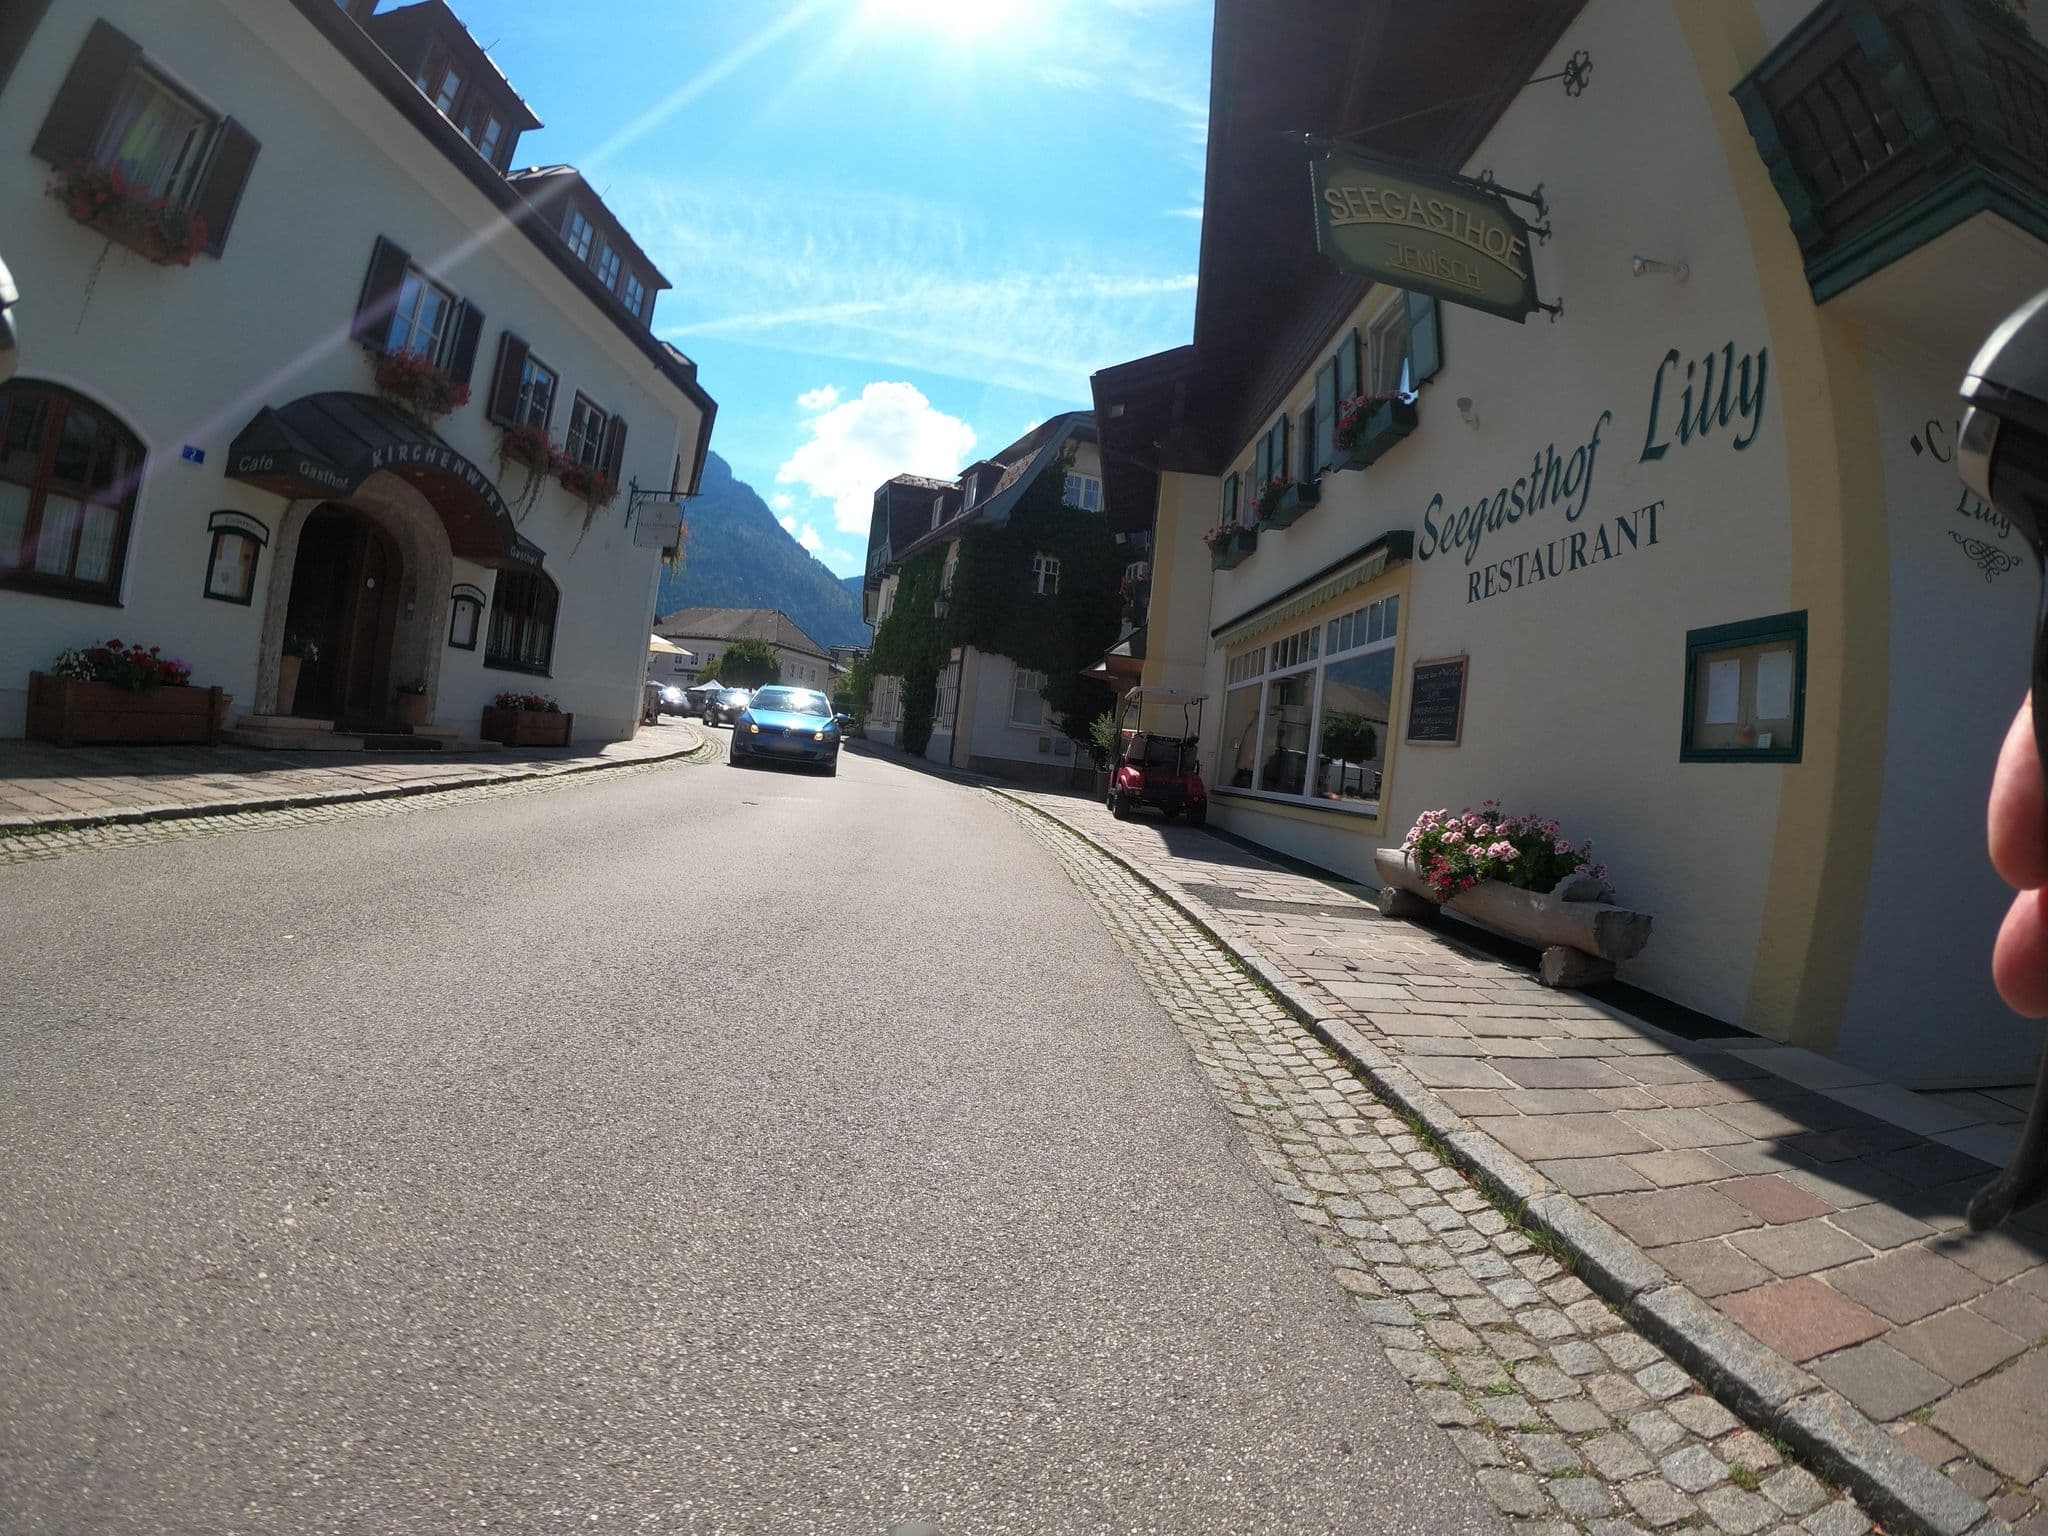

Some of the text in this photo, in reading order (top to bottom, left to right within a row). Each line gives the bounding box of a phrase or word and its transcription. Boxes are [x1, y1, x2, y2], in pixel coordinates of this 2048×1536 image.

[1323, 186, 1526, 266] SEEGASTHOF
[299, 460, 350, 489] Gasthof
[372, 443, 507, 518] KIRCHENWIRT
[1418, 341, 1767, 566] Seegasthof Lilly
[1466, 500, 1665, 604] RESTAURANT
